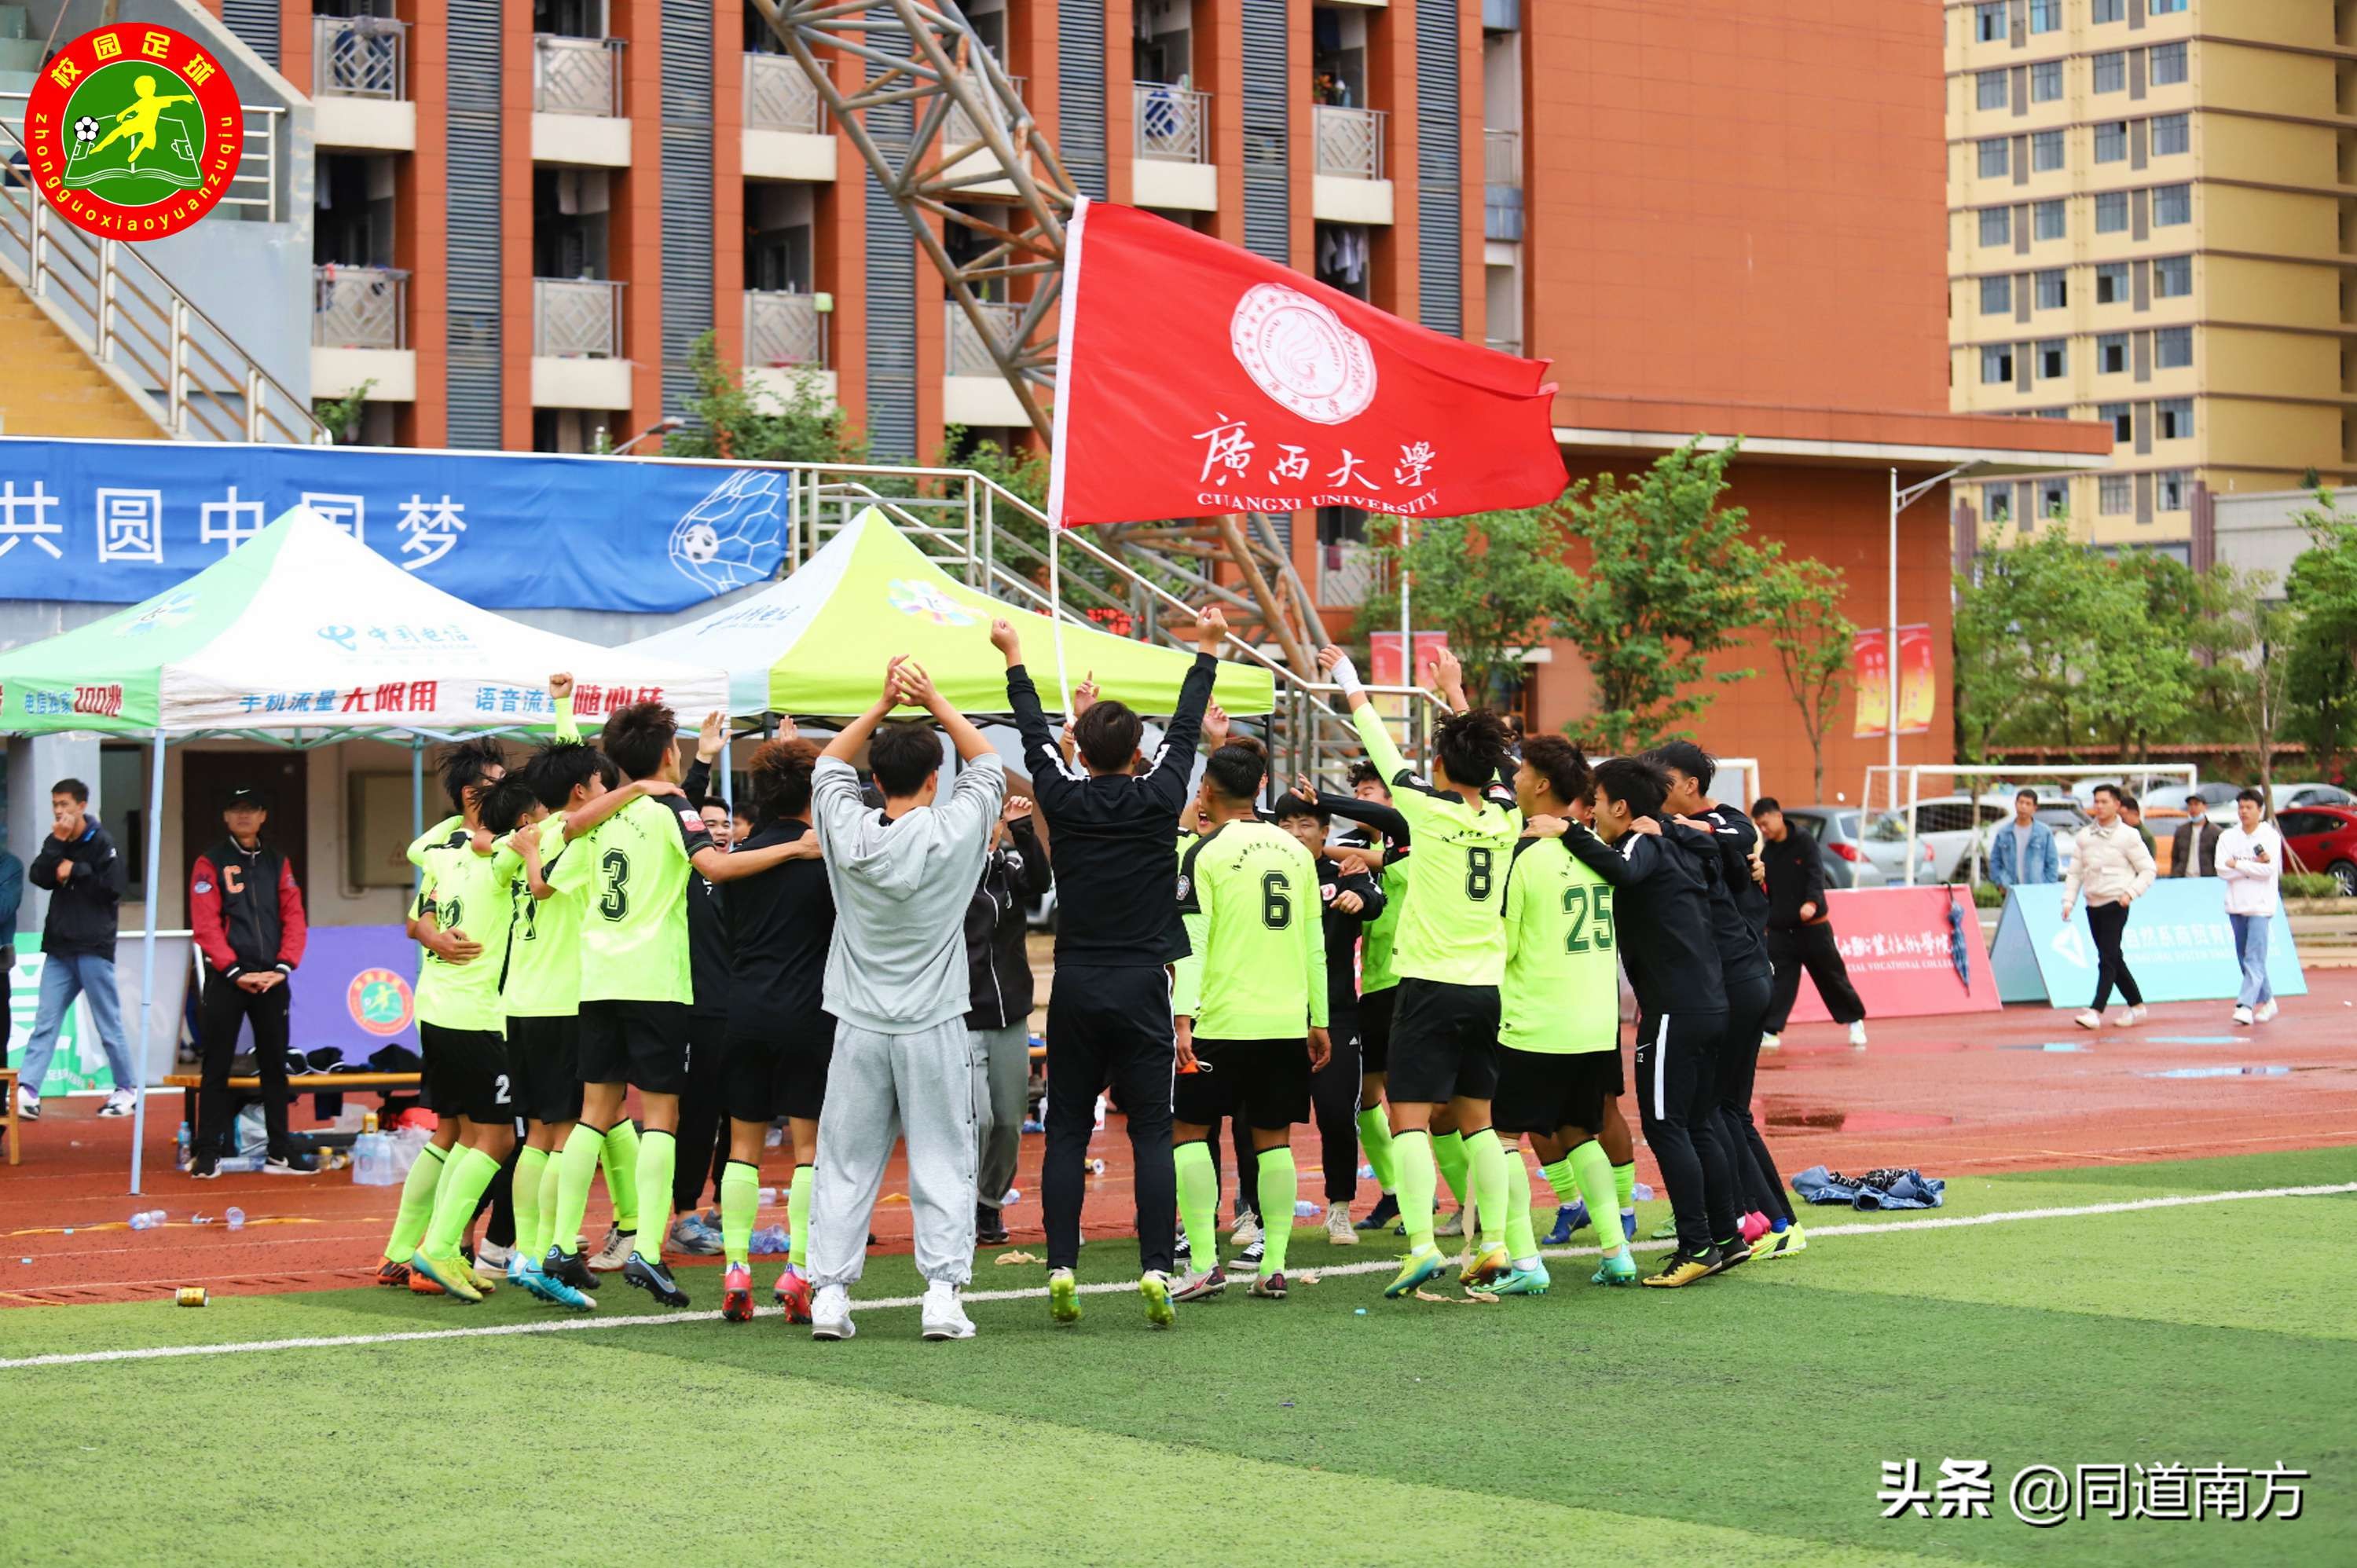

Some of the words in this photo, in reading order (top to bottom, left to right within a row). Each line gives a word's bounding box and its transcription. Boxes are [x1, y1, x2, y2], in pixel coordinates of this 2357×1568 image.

[1197, 493, 1302, 511] GUANGXI
[1311, 489, 1439, 514] UNIVERSITY
[223, 865, 245, 893] C
[598, 848, 630, 922] 3
[1465, 846, 1494, 902] 8
[1261, 870, 1292, 930] 6
[1561, 882, 1614, 955] 25
[1922, 958, 1954, 969] COLLEG
[495, 1074, 511, 1104] 2
